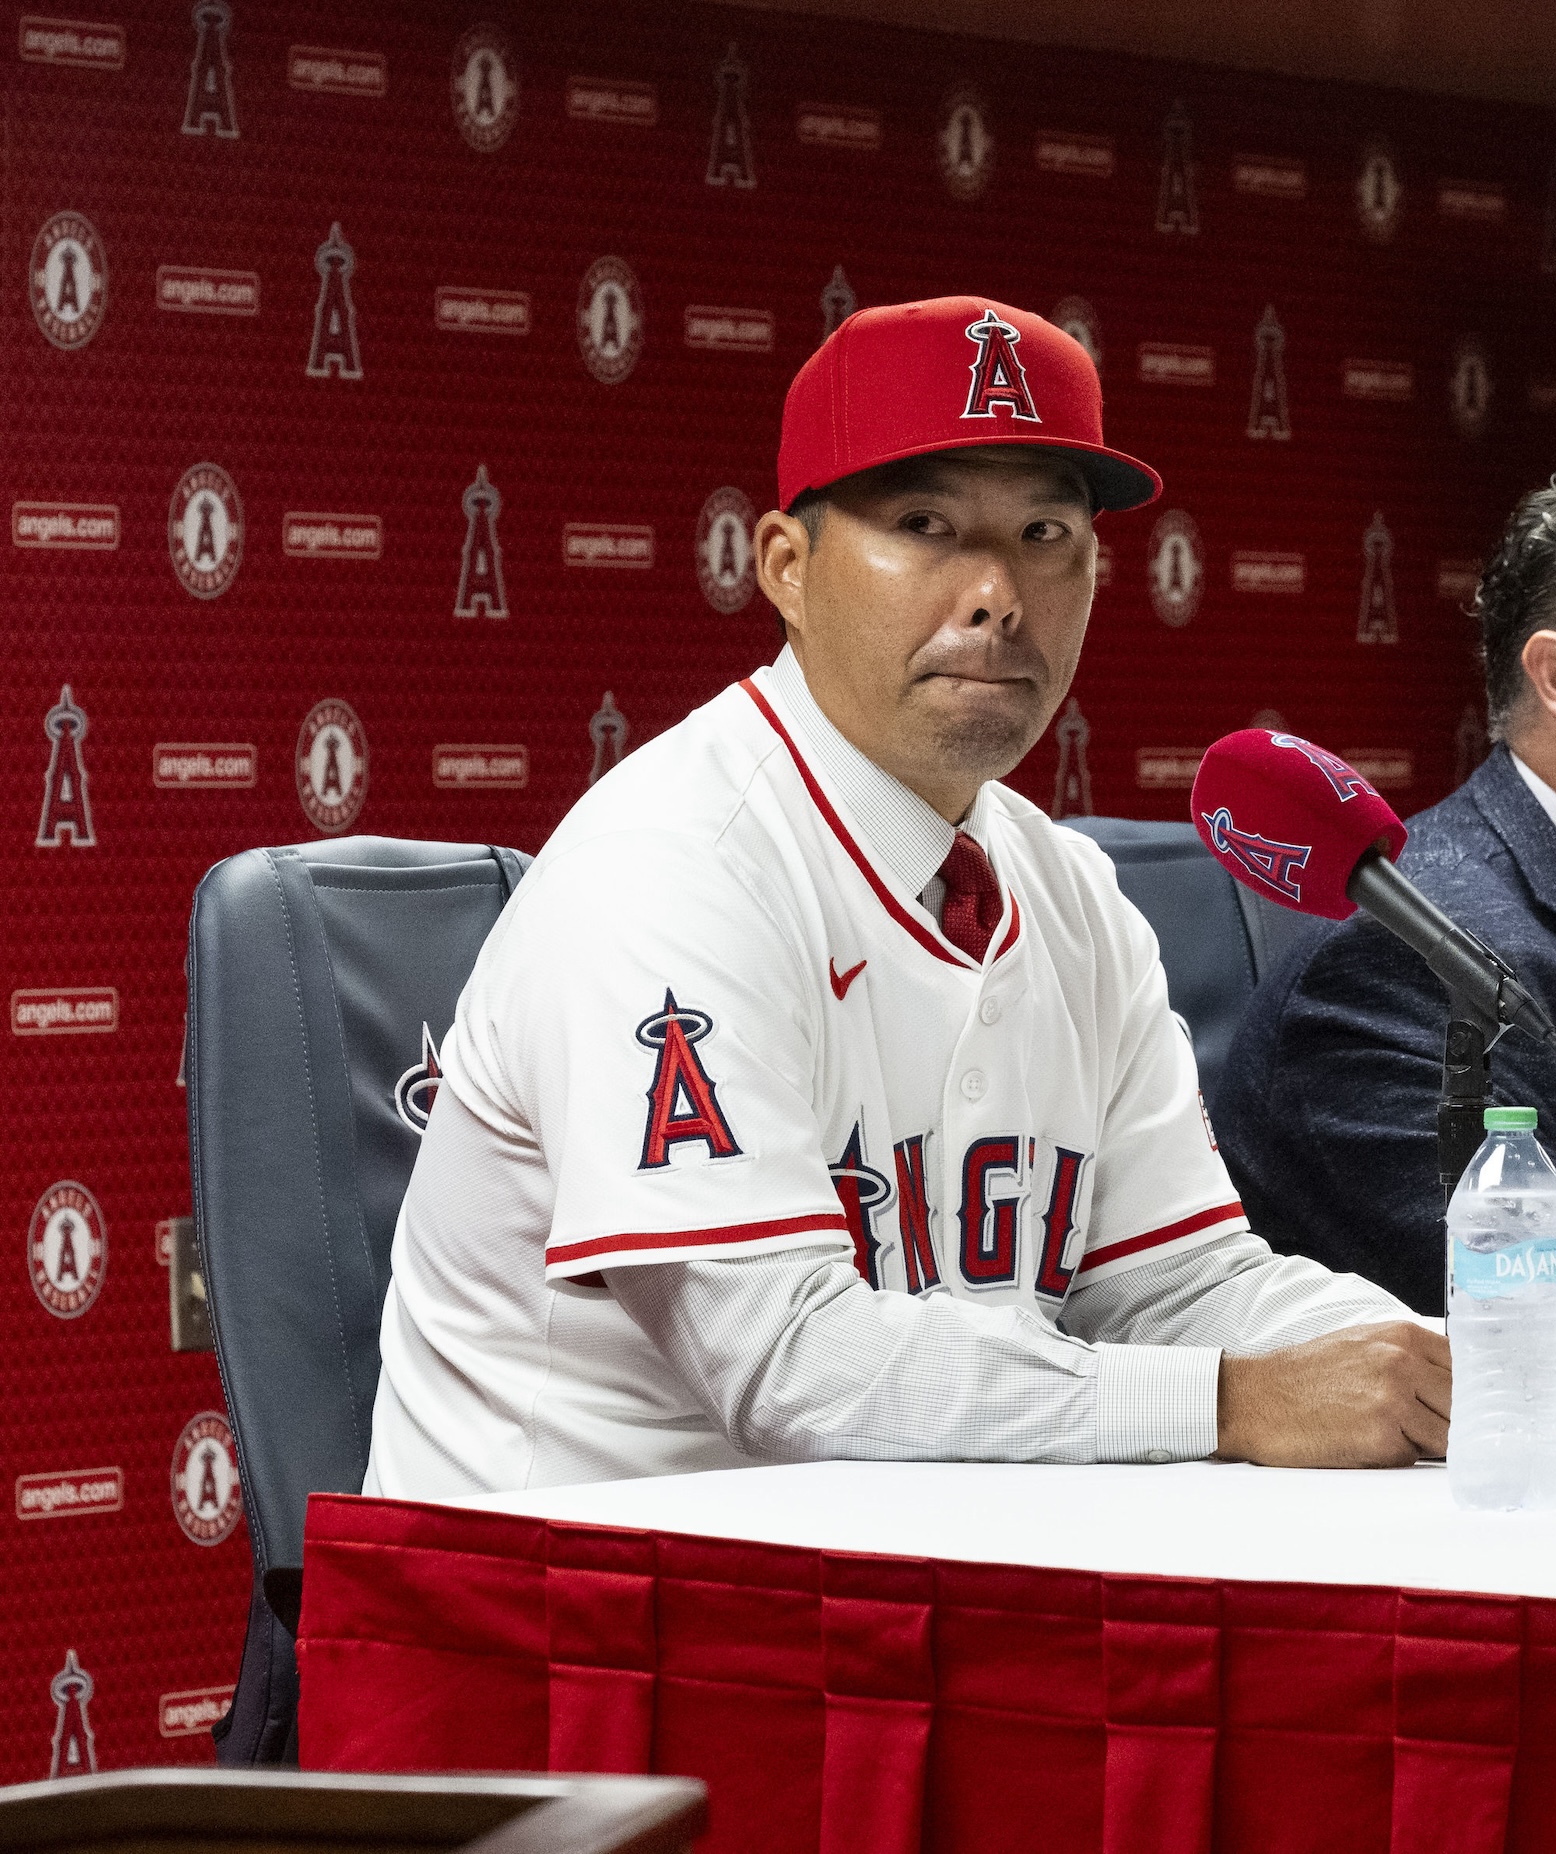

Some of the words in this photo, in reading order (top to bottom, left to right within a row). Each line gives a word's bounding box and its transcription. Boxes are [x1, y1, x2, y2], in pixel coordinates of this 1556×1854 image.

[24, 29, 121, 59] angels.com
[291, 58, 383, 87] angels.com
[161, 278, 255, 306] angels.com
[959, 309, 1043, 423] A
[17, 511, 114, 542] angels.com
[288, 522, 379, 552] angels.com
[35, 683, 96, 847] A
[158, 752, 251, 782] angels.com
[436, 754, 526, 780] angels.com
[1265, 729, 1381, 803] A
[1201, 806, 1313, 904] A
[16, 997, 113, 1029] angels.com
[632, 986, 752, 1175] A
[20, 1478, 118, 1512] angels.com
[164, 1699, 233, 1728] angels.c
